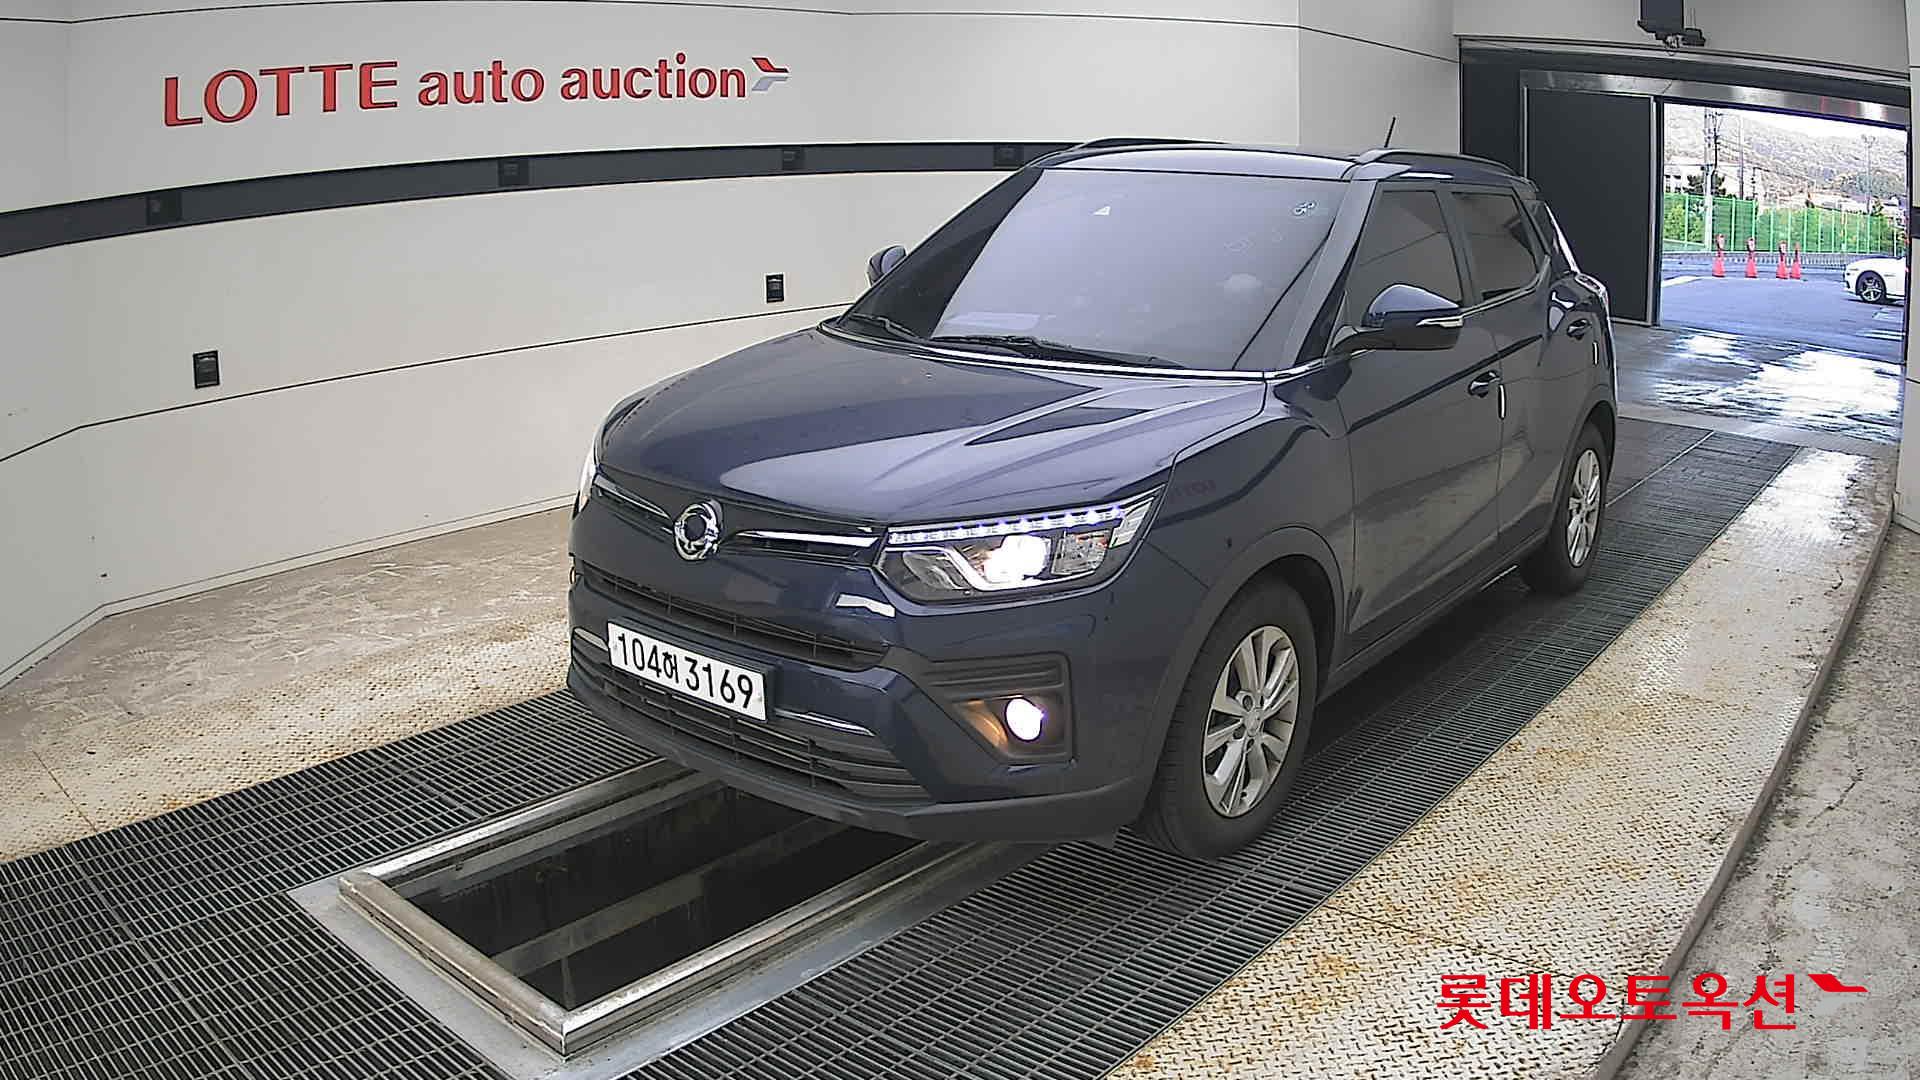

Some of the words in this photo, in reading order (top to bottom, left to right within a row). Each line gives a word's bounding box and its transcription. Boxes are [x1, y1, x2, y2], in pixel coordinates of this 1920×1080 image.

[163, 61, 399, 126] LOTTE
[418, 60, 544, 106] auto
[561, 53, 746, 100] auction
